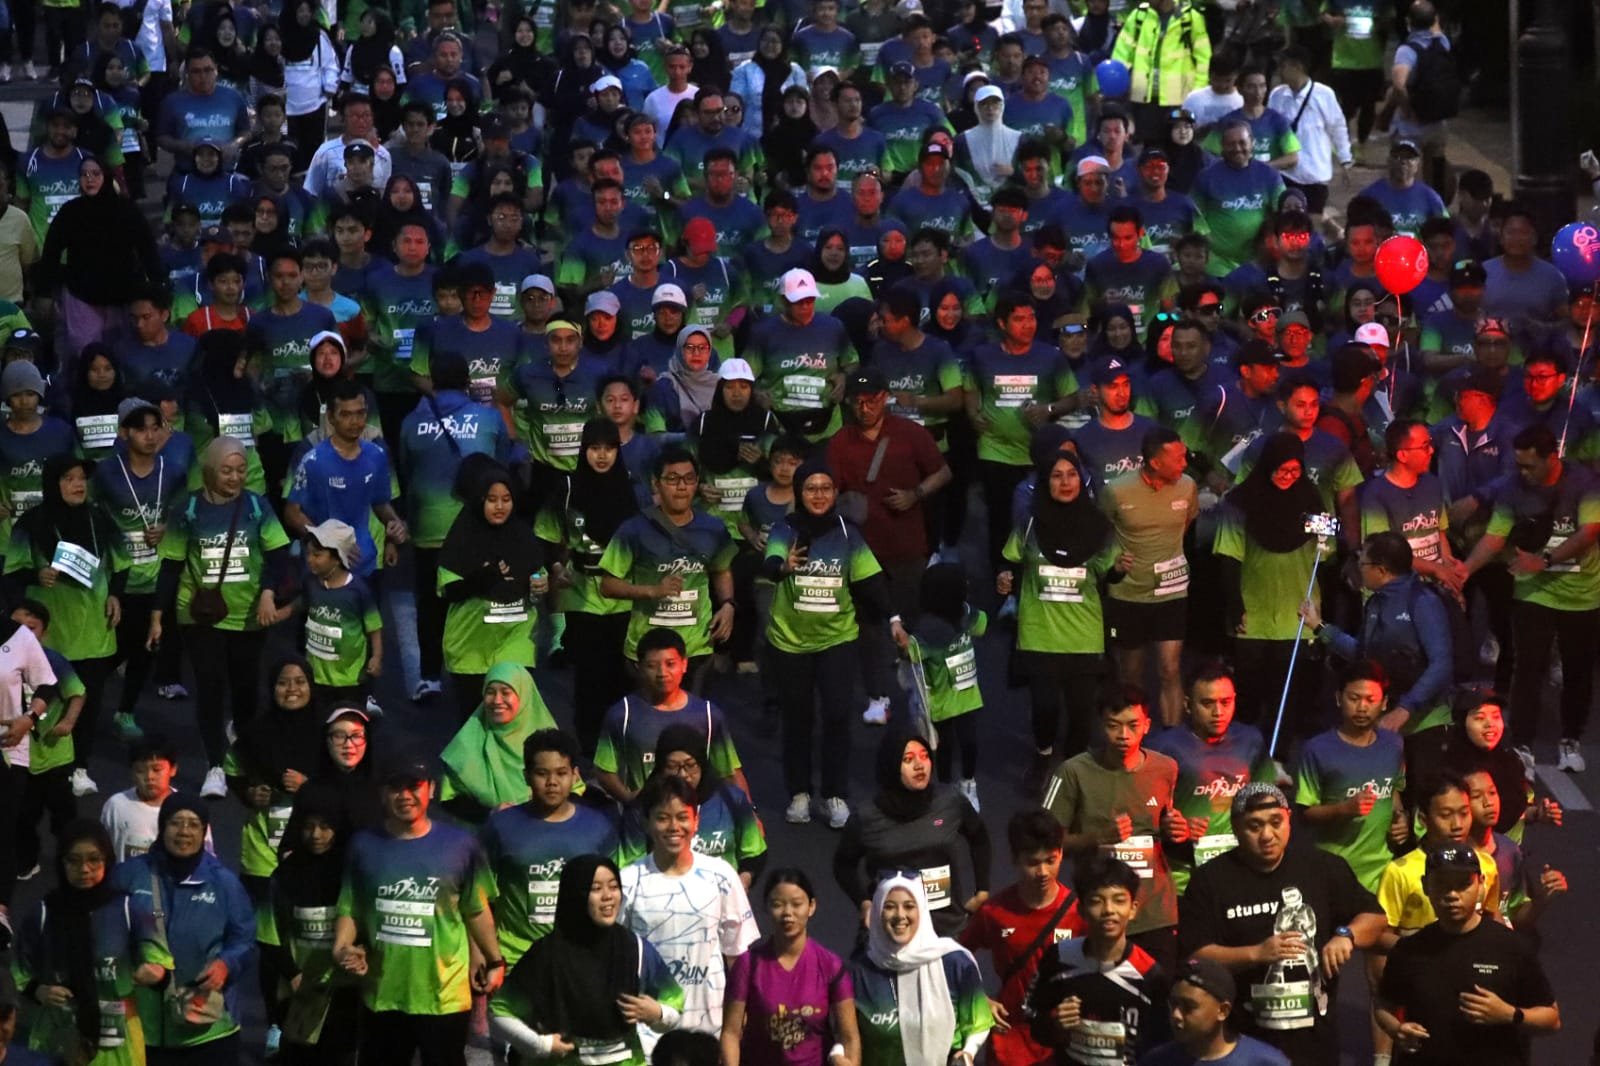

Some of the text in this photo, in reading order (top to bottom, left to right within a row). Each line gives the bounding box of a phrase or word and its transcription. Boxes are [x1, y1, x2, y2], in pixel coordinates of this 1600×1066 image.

[84, 425, 115, 434] 03501
[550, 435, 578, 443] 10677
[1047, 578, 1076, 587] 11417
[802, 588, 834, 597] 10851
[1227, 901, 1279, 919] stussy
[384, 916, 423, 927] 10104
[1266, 999, 1302, 1010] 11101
